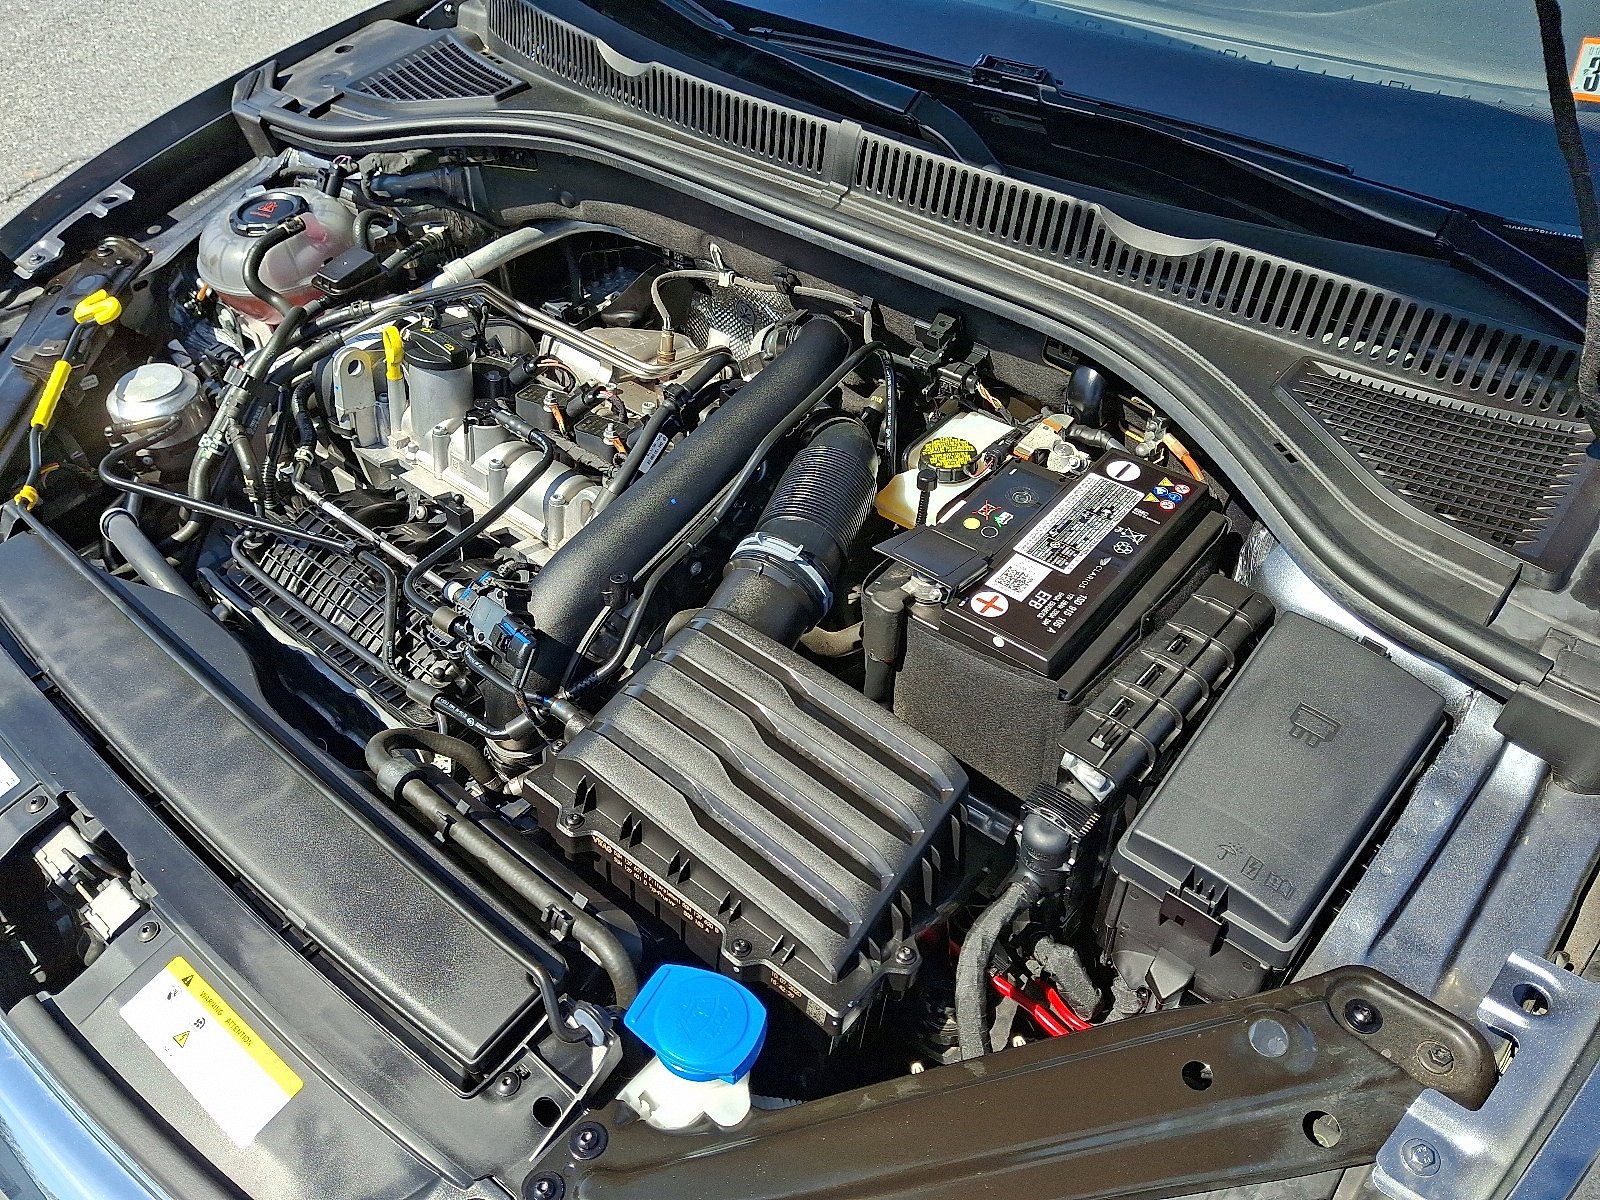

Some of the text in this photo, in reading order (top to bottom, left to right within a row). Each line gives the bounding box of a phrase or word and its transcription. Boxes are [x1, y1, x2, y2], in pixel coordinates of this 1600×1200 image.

[1078, 565, 1103, 588] CLARIOS
[1028, 589, 1053, 610] EFB
[1046, 626, 1057, 634] A
[199, 990, 254, 1047] WARNING ATTENTION
